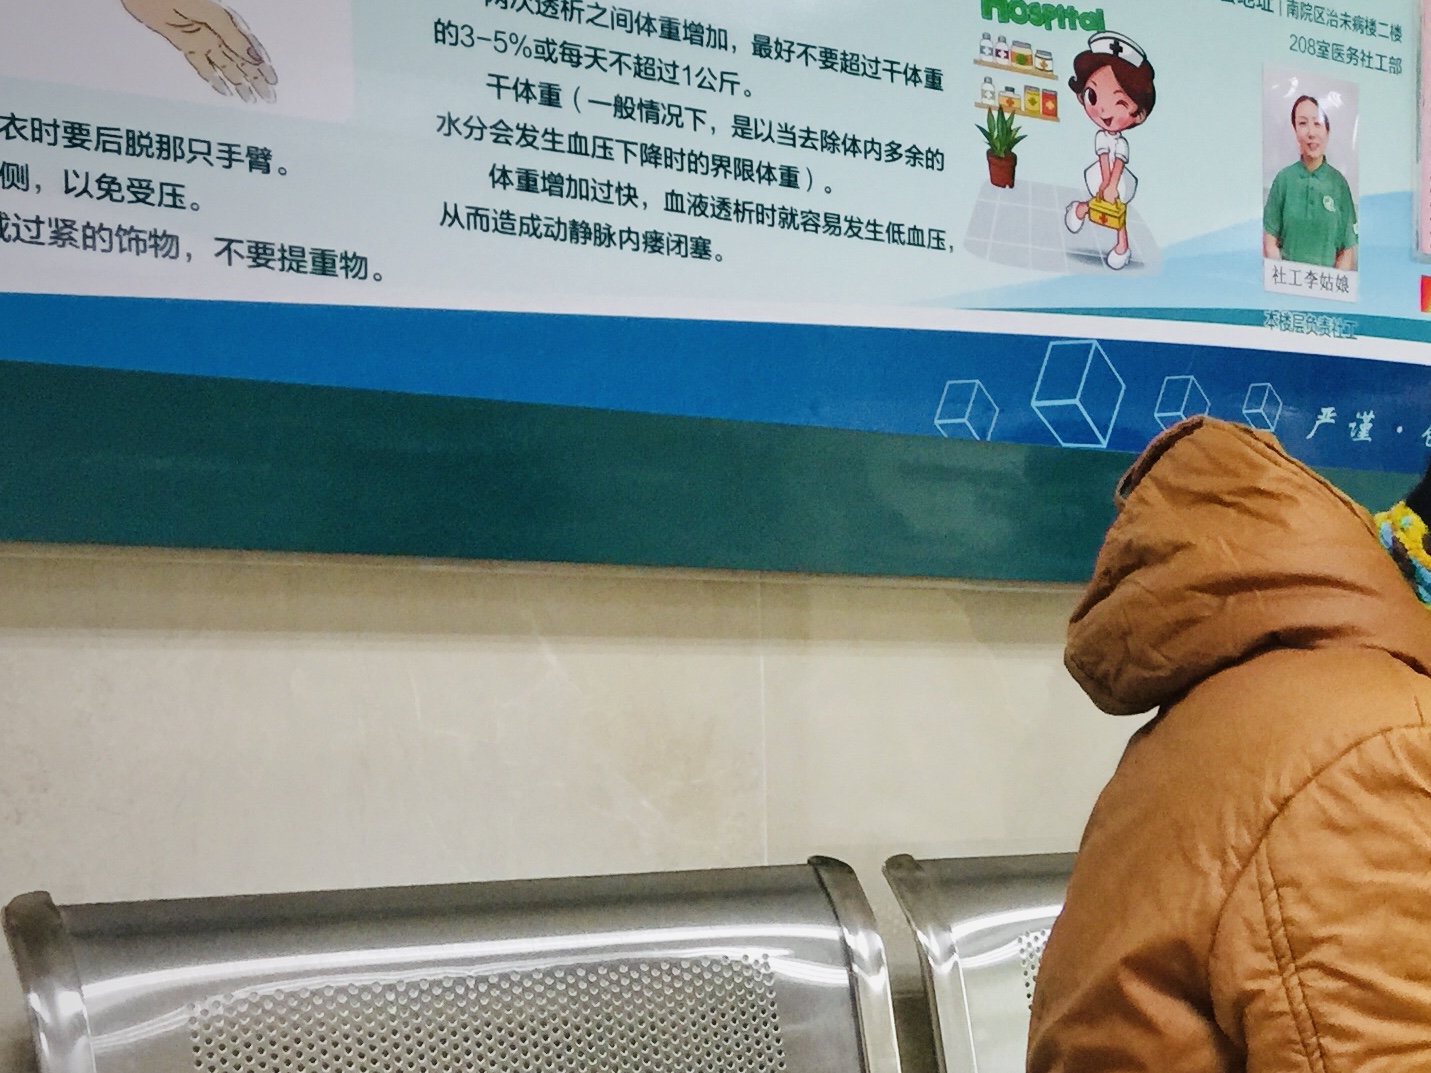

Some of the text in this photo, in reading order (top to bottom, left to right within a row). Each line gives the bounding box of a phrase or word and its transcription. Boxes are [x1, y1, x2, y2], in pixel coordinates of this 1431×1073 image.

[1289, 34, 1402, 75] 208室医务社工部
[1272, 265, 1349, 293] 社工李姑娘
[1263, 310, 1358, 340] 本楼层负责社工
